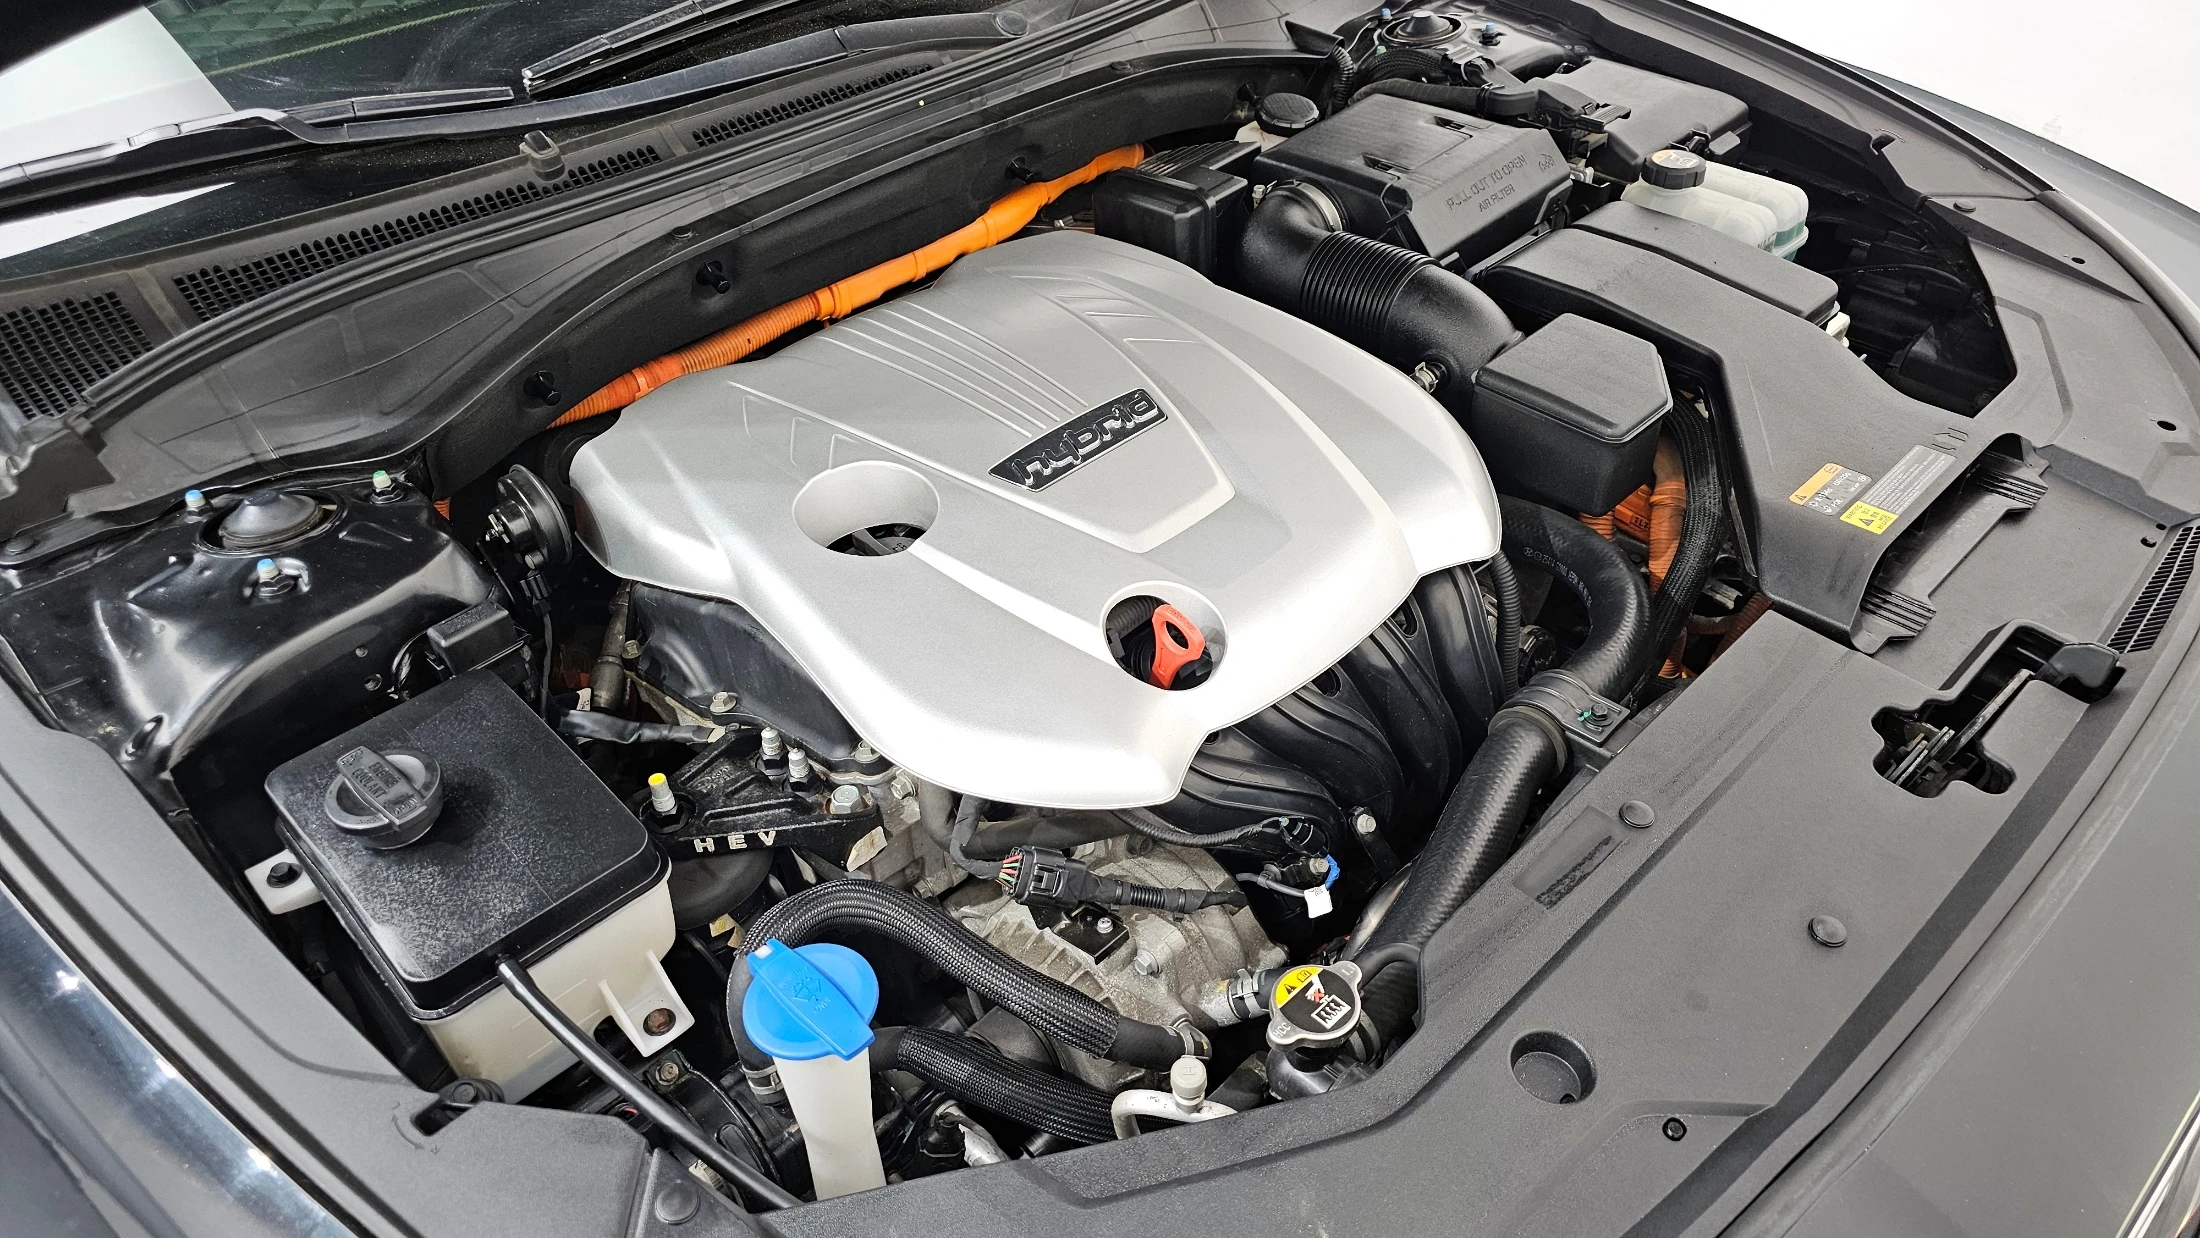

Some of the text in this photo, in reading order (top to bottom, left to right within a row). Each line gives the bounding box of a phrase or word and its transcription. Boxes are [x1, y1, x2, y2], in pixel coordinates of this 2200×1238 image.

[1446, 189, 1472, 210] PULL
[1470, 177, 1490, 195] OUT
[1490, 169, 1503, 184] TO
[1501, 154, 1528, 175] OPEN
[1478, 183, 1516, 212] AIR FILTER
[1011, 390, 1159, 487] hybrid
[352, 767, 389, 799] COOLANT
[369, 761, 400, 793] ENGINE
[393, 797, 418, 816] OPEN
[693, 830, 777, 853] HEV
[1272, 1022, 1292, 1039] HCC
